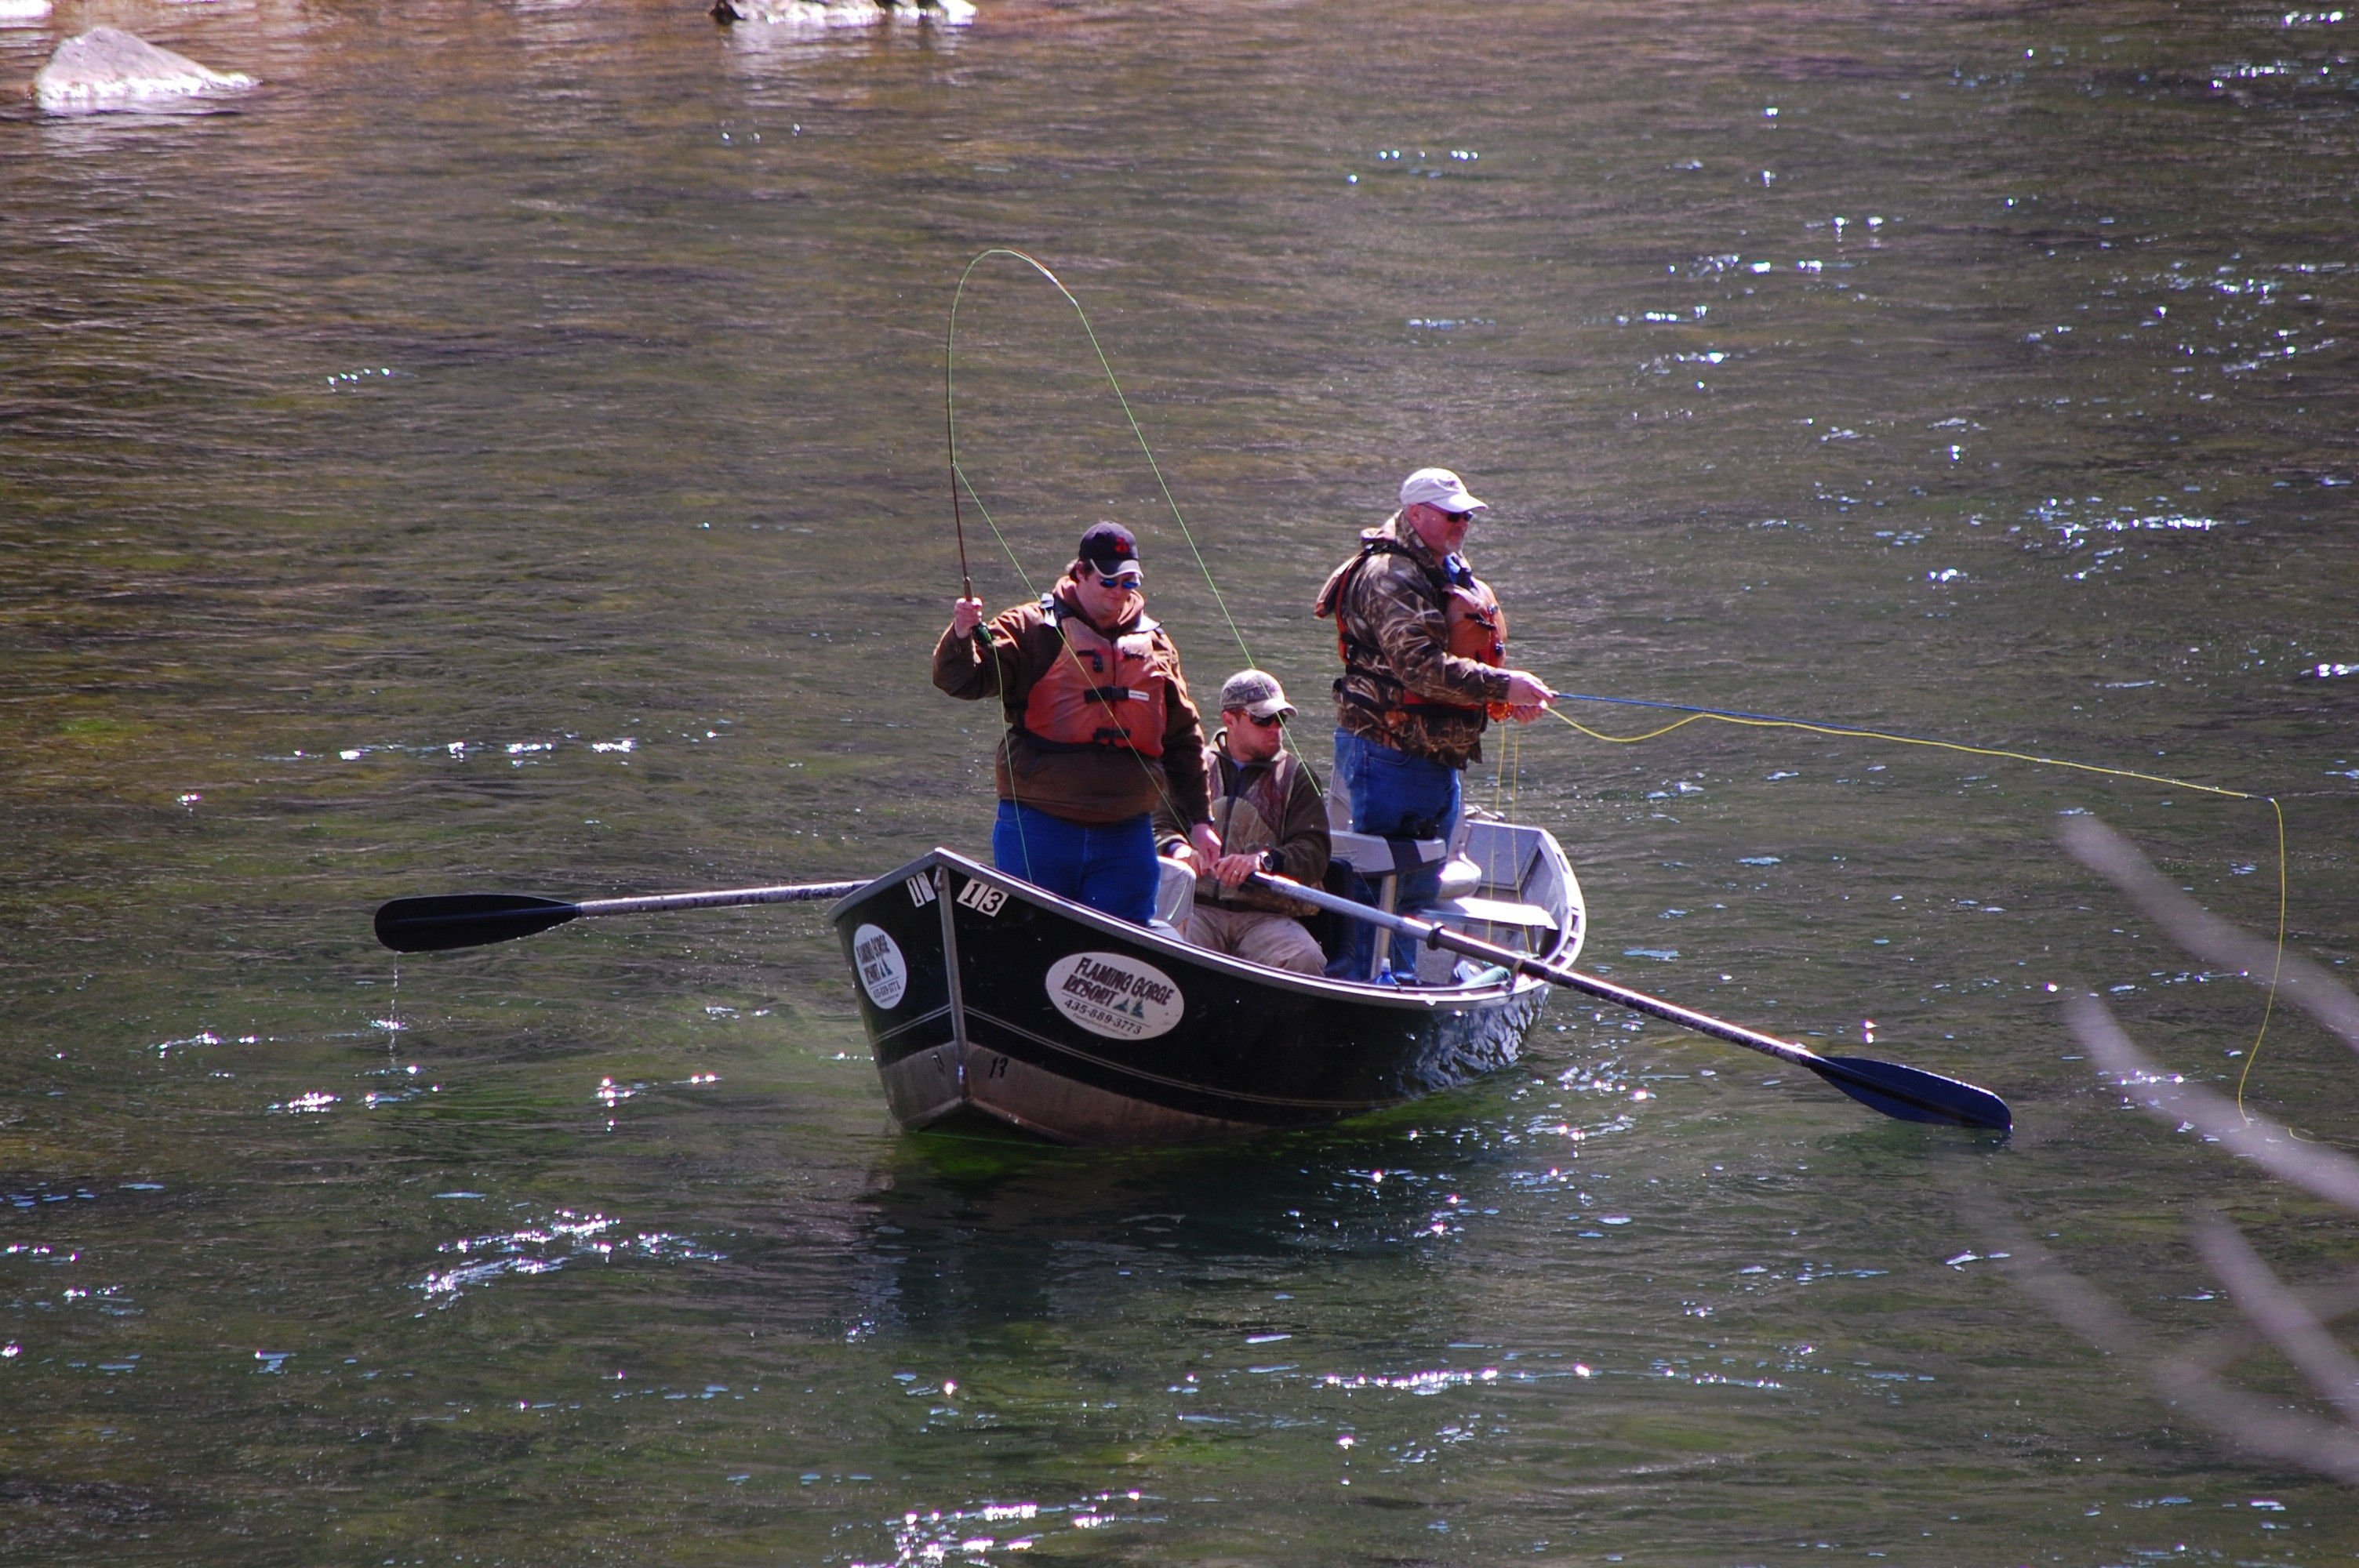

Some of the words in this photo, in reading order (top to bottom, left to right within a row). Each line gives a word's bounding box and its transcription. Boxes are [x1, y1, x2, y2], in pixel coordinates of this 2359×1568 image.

[963, 883, 1003, 913] 13
[1063, 975, 1118, 1007] RESORT
[1074, 957, 1134, 993] FLAMING
[1132, 977, 1175, 1006] GORGE
[1064, 1000, 1142, 1034] 435-889-3773
